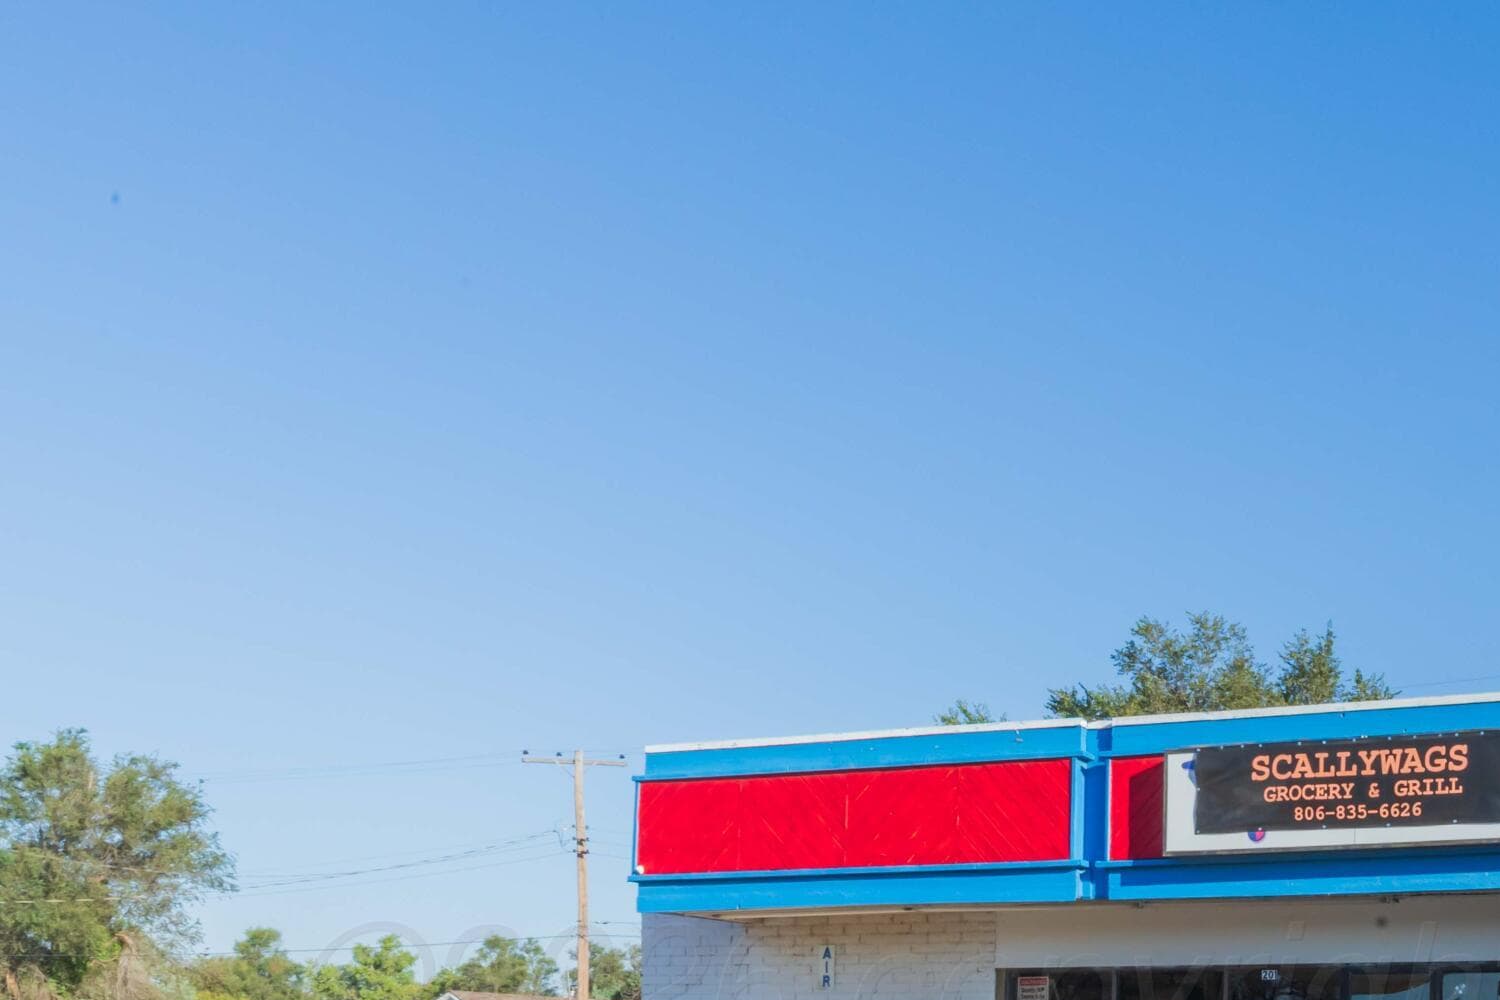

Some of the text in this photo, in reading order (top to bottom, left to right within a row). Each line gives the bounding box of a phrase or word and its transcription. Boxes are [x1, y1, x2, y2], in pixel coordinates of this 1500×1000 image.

[1251, 744, 1469, 781] SCALLYWAGS
[1263, 777, 1463, 802] GROCERY & GRILL
[1294, 802, 1422, 821] 806-835-6626
[822, 946, 832, 987] AIR
